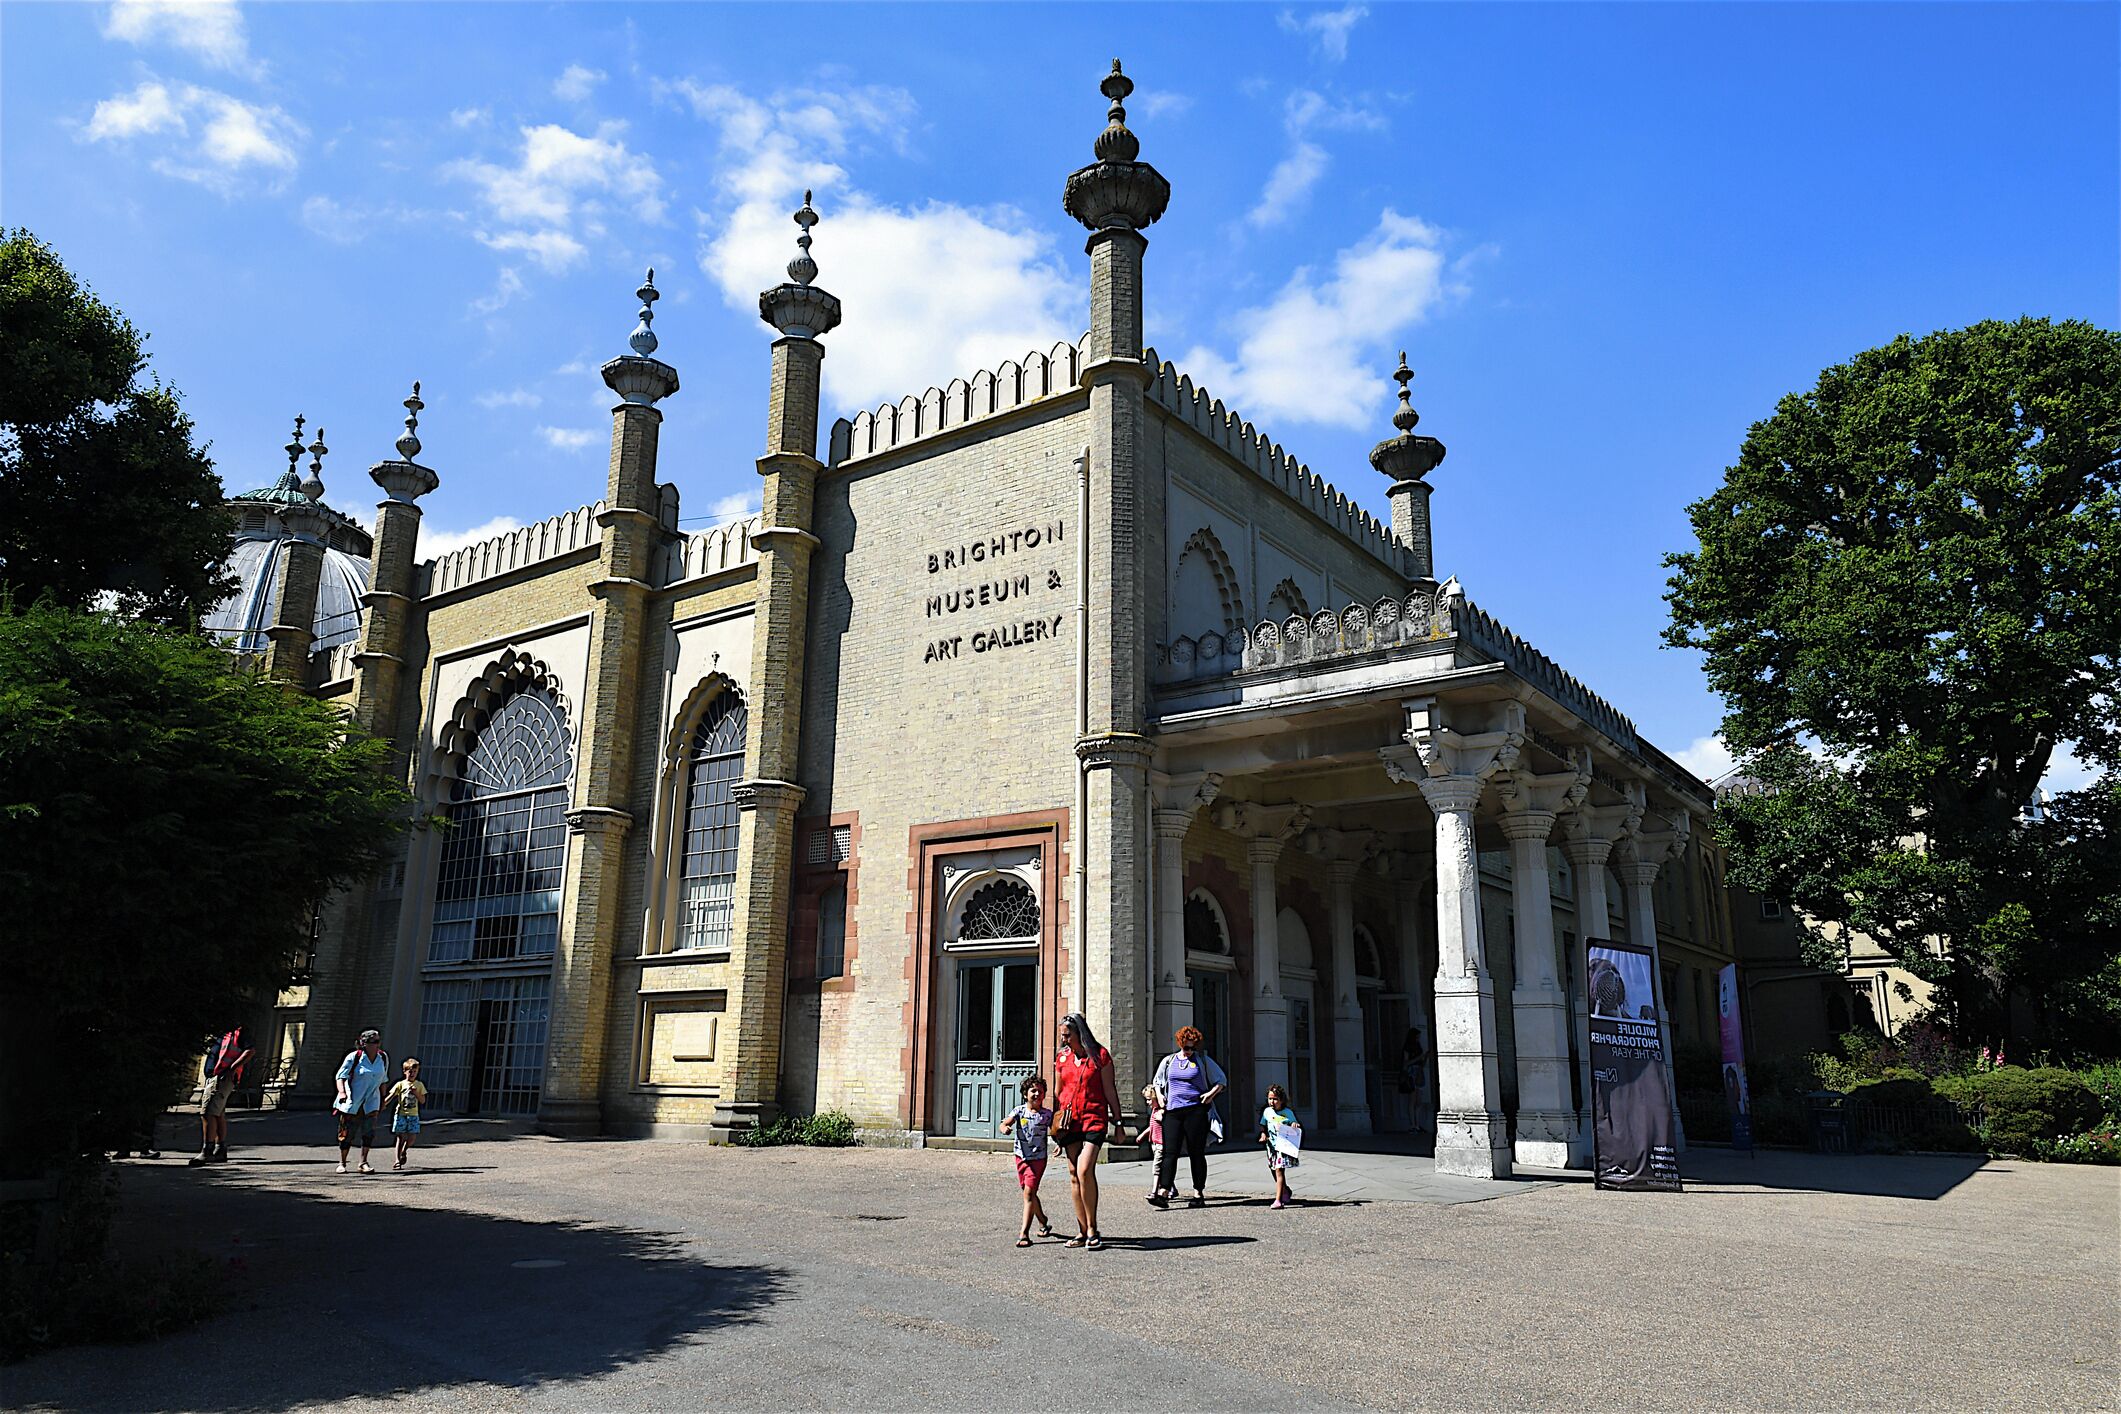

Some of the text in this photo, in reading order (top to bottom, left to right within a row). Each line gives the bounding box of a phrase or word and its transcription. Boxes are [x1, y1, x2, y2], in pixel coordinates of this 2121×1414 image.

[927, 520, 1063, 573] BRIGHTON
[926, 568, 1062, 618] MUSEUM &
[924, 614, 1063, 664] ART GALLERY
